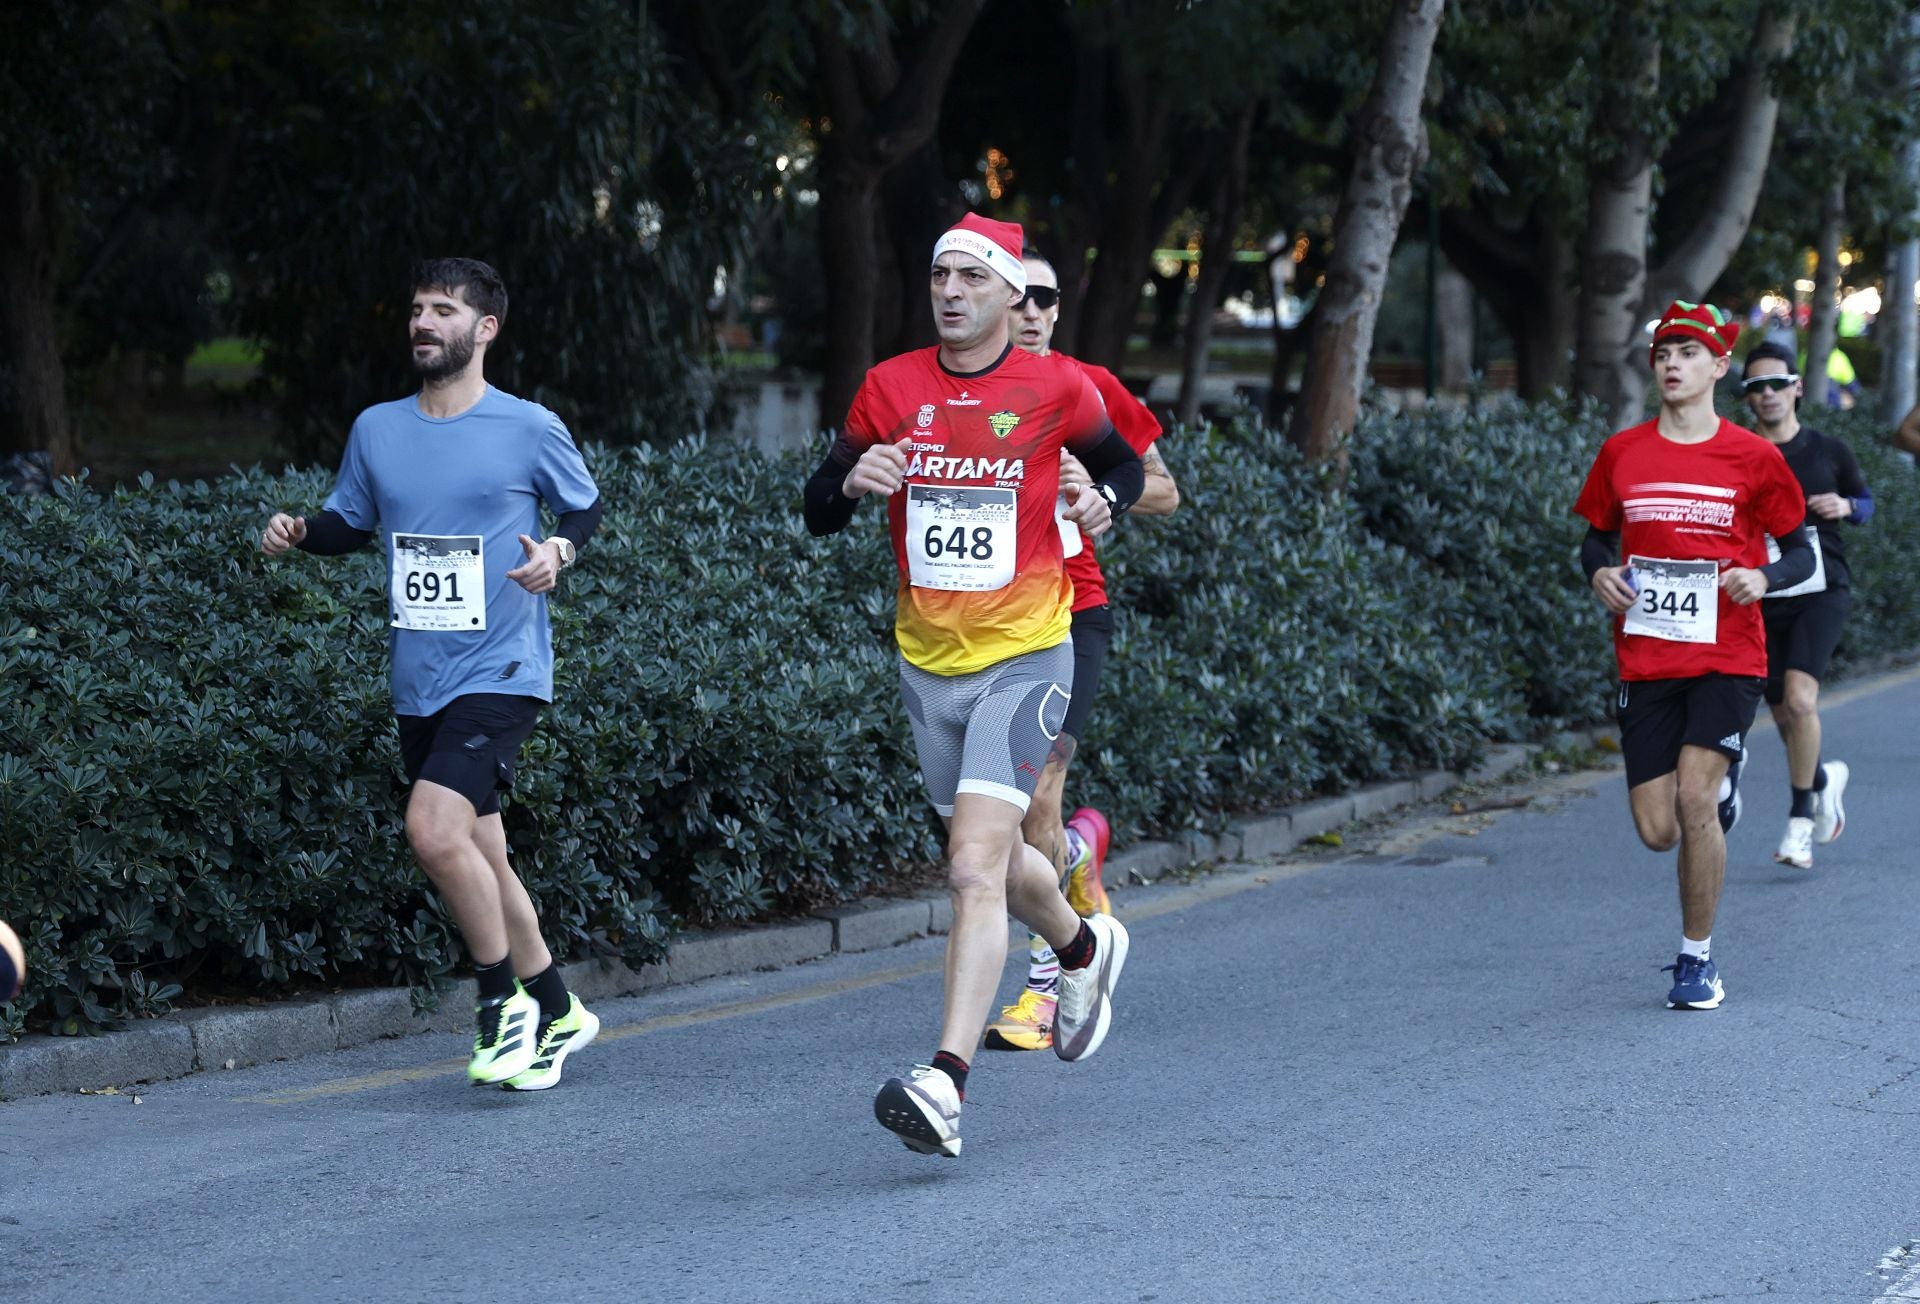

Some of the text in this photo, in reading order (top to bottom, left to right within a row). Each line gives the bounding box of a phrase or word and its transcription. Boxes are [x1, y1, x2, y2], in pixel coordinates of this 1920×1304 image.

[977, 503, 1014, 511] XIV
[1690, 500, 1735, 512] CARRERA
[1651, 512, 1733, 527] PALMA PALMILLA
[924, 525, 993, 560] 648
[405, 571, 464, 602] 691
[1642, 588, 1699, 617] 344
